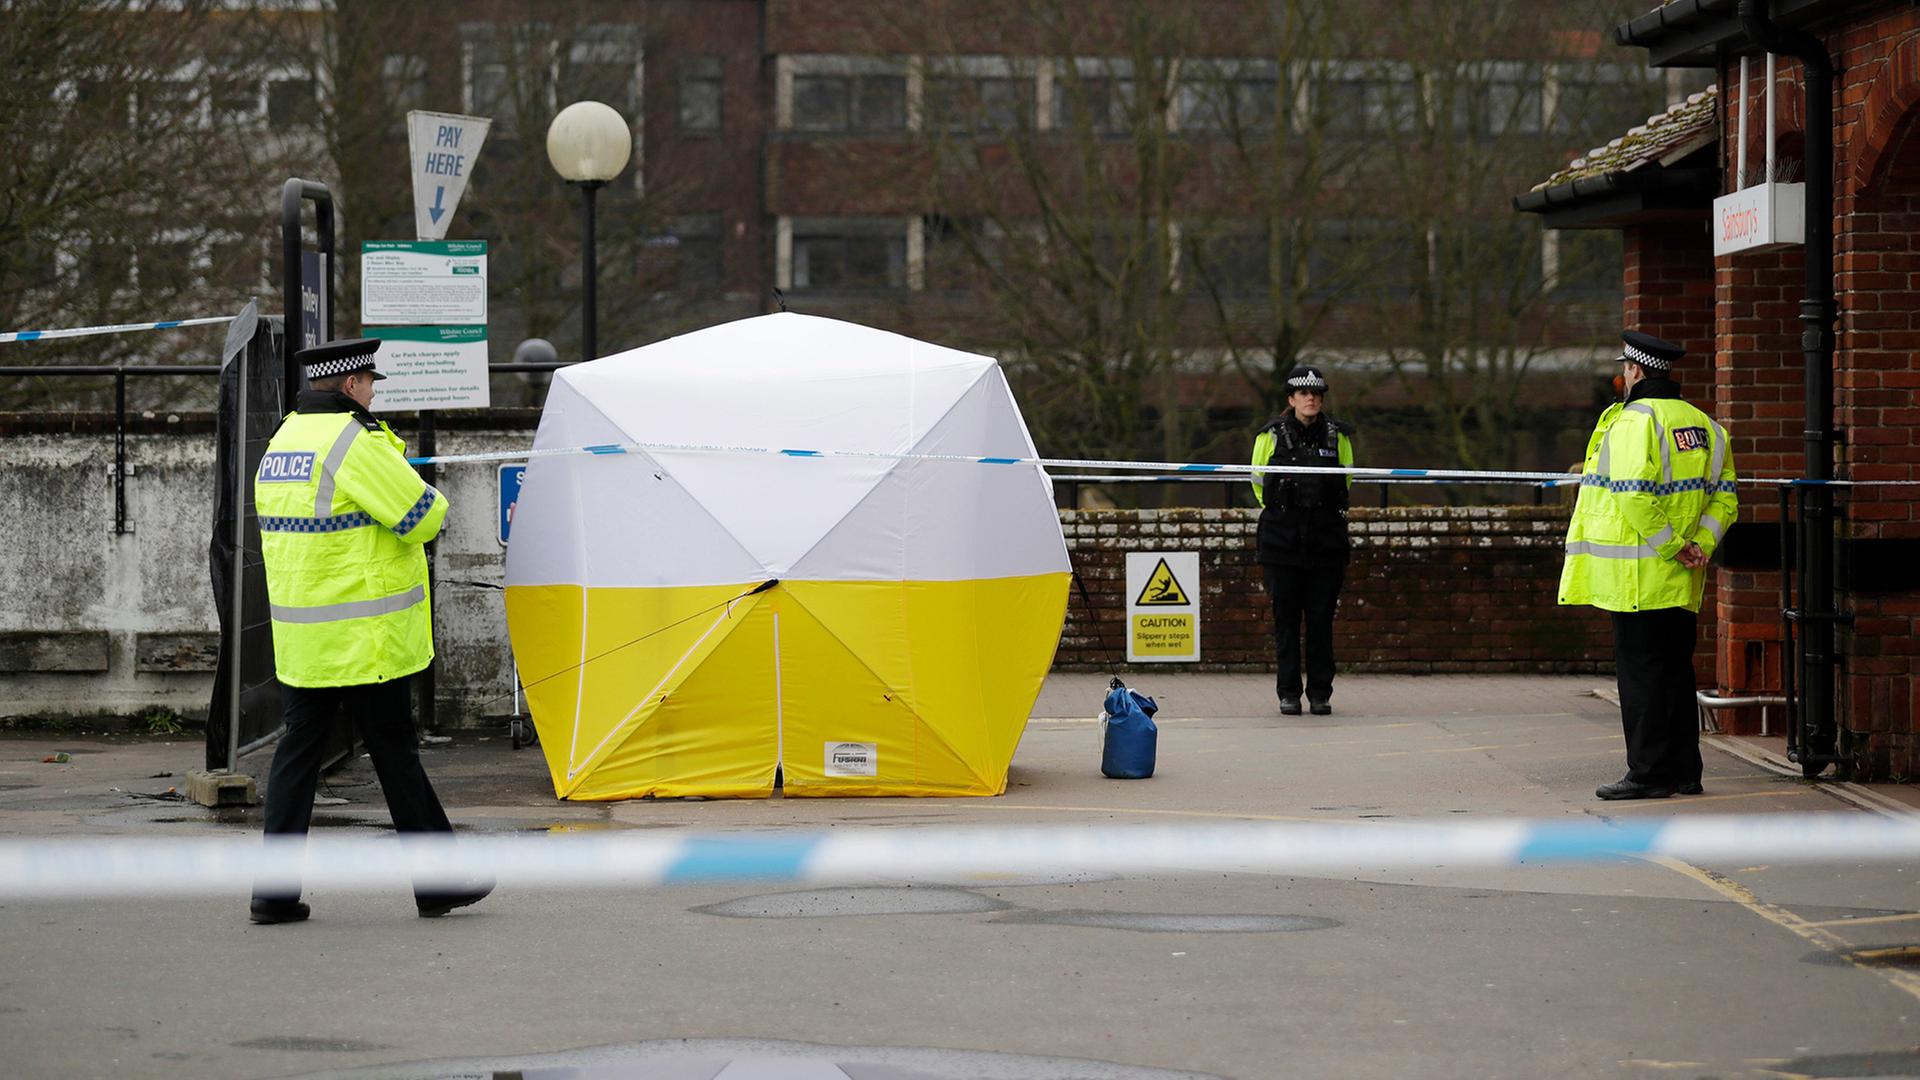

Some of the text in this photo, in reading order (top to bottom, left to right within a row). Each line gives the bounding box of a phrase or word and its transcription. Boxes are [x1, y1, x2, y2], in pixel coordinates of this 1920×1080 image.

[436, 125, 463, 149] PAY
[425, 152, 465, 177] HERE
[1721, 204, 1758, 243] Sainsbury's
[443, 350, 460, 358] apply
[1675, 429, 1710, 450] POLIC
[260, 455, 312, 477] POLICE
[1140, 618, 1187, 628] CAUTION
[1136, 632, 1190, 641] Slippery steps
[832, 752, 867, 764] Fusion
